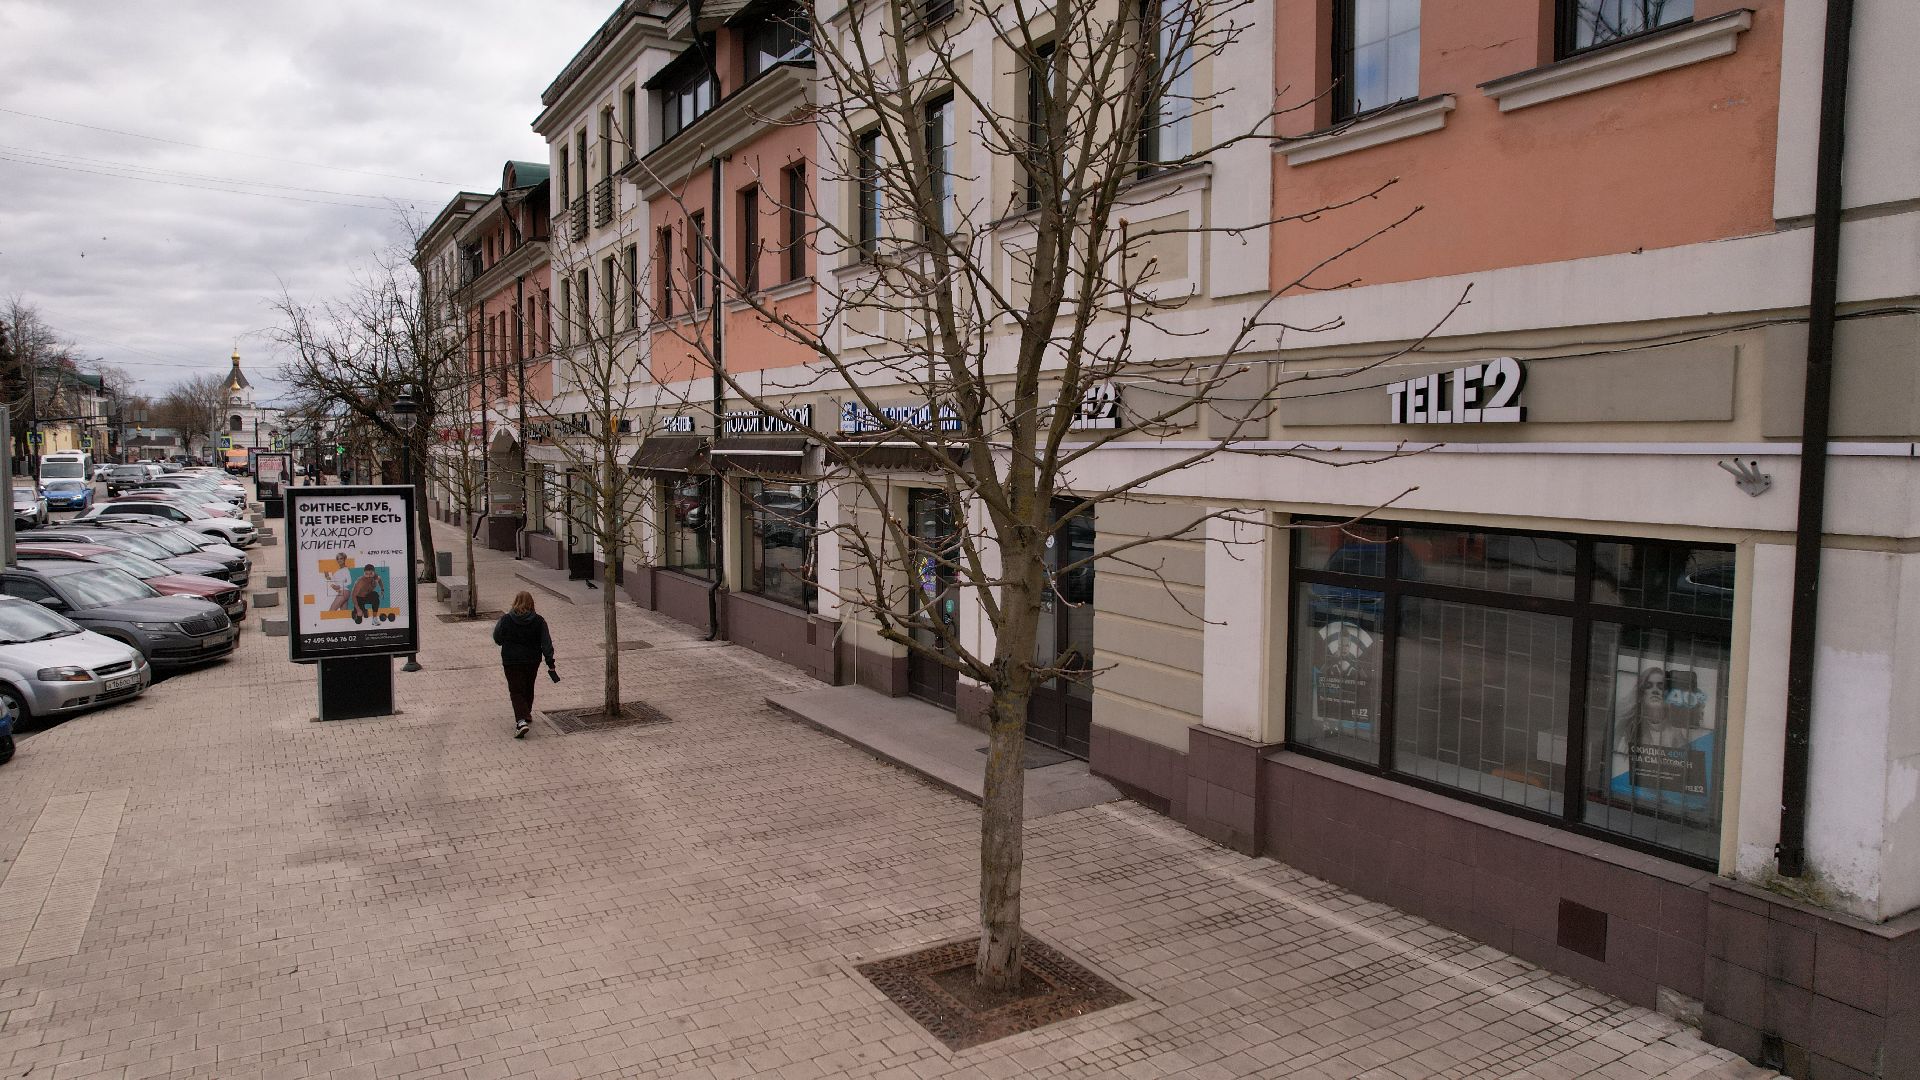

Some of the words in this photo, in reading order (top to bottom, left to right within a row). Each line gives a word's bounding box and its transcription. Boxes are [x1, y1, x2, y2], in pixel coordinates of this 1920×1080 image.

[1386, 356, 1526, 424] TELE2
[1048, 382, 1120, 429] LE2
[889, 404, 958, 431] ЭЛЕКТРОИКИ
[299, 501, 392, 513] ФИТНЕС-КЛУБ,
[299, 515, 322, 526] ГДЕ
[324, 514, 369, 525] ТРЕНЕР
[371, 513, 402, 524] ЕСТЬ
[300, 527, 309, 538] У
[311, 526, 374, 538] КАЖДОГО
[300, 539, 356, 550] КЛИЕНТА
